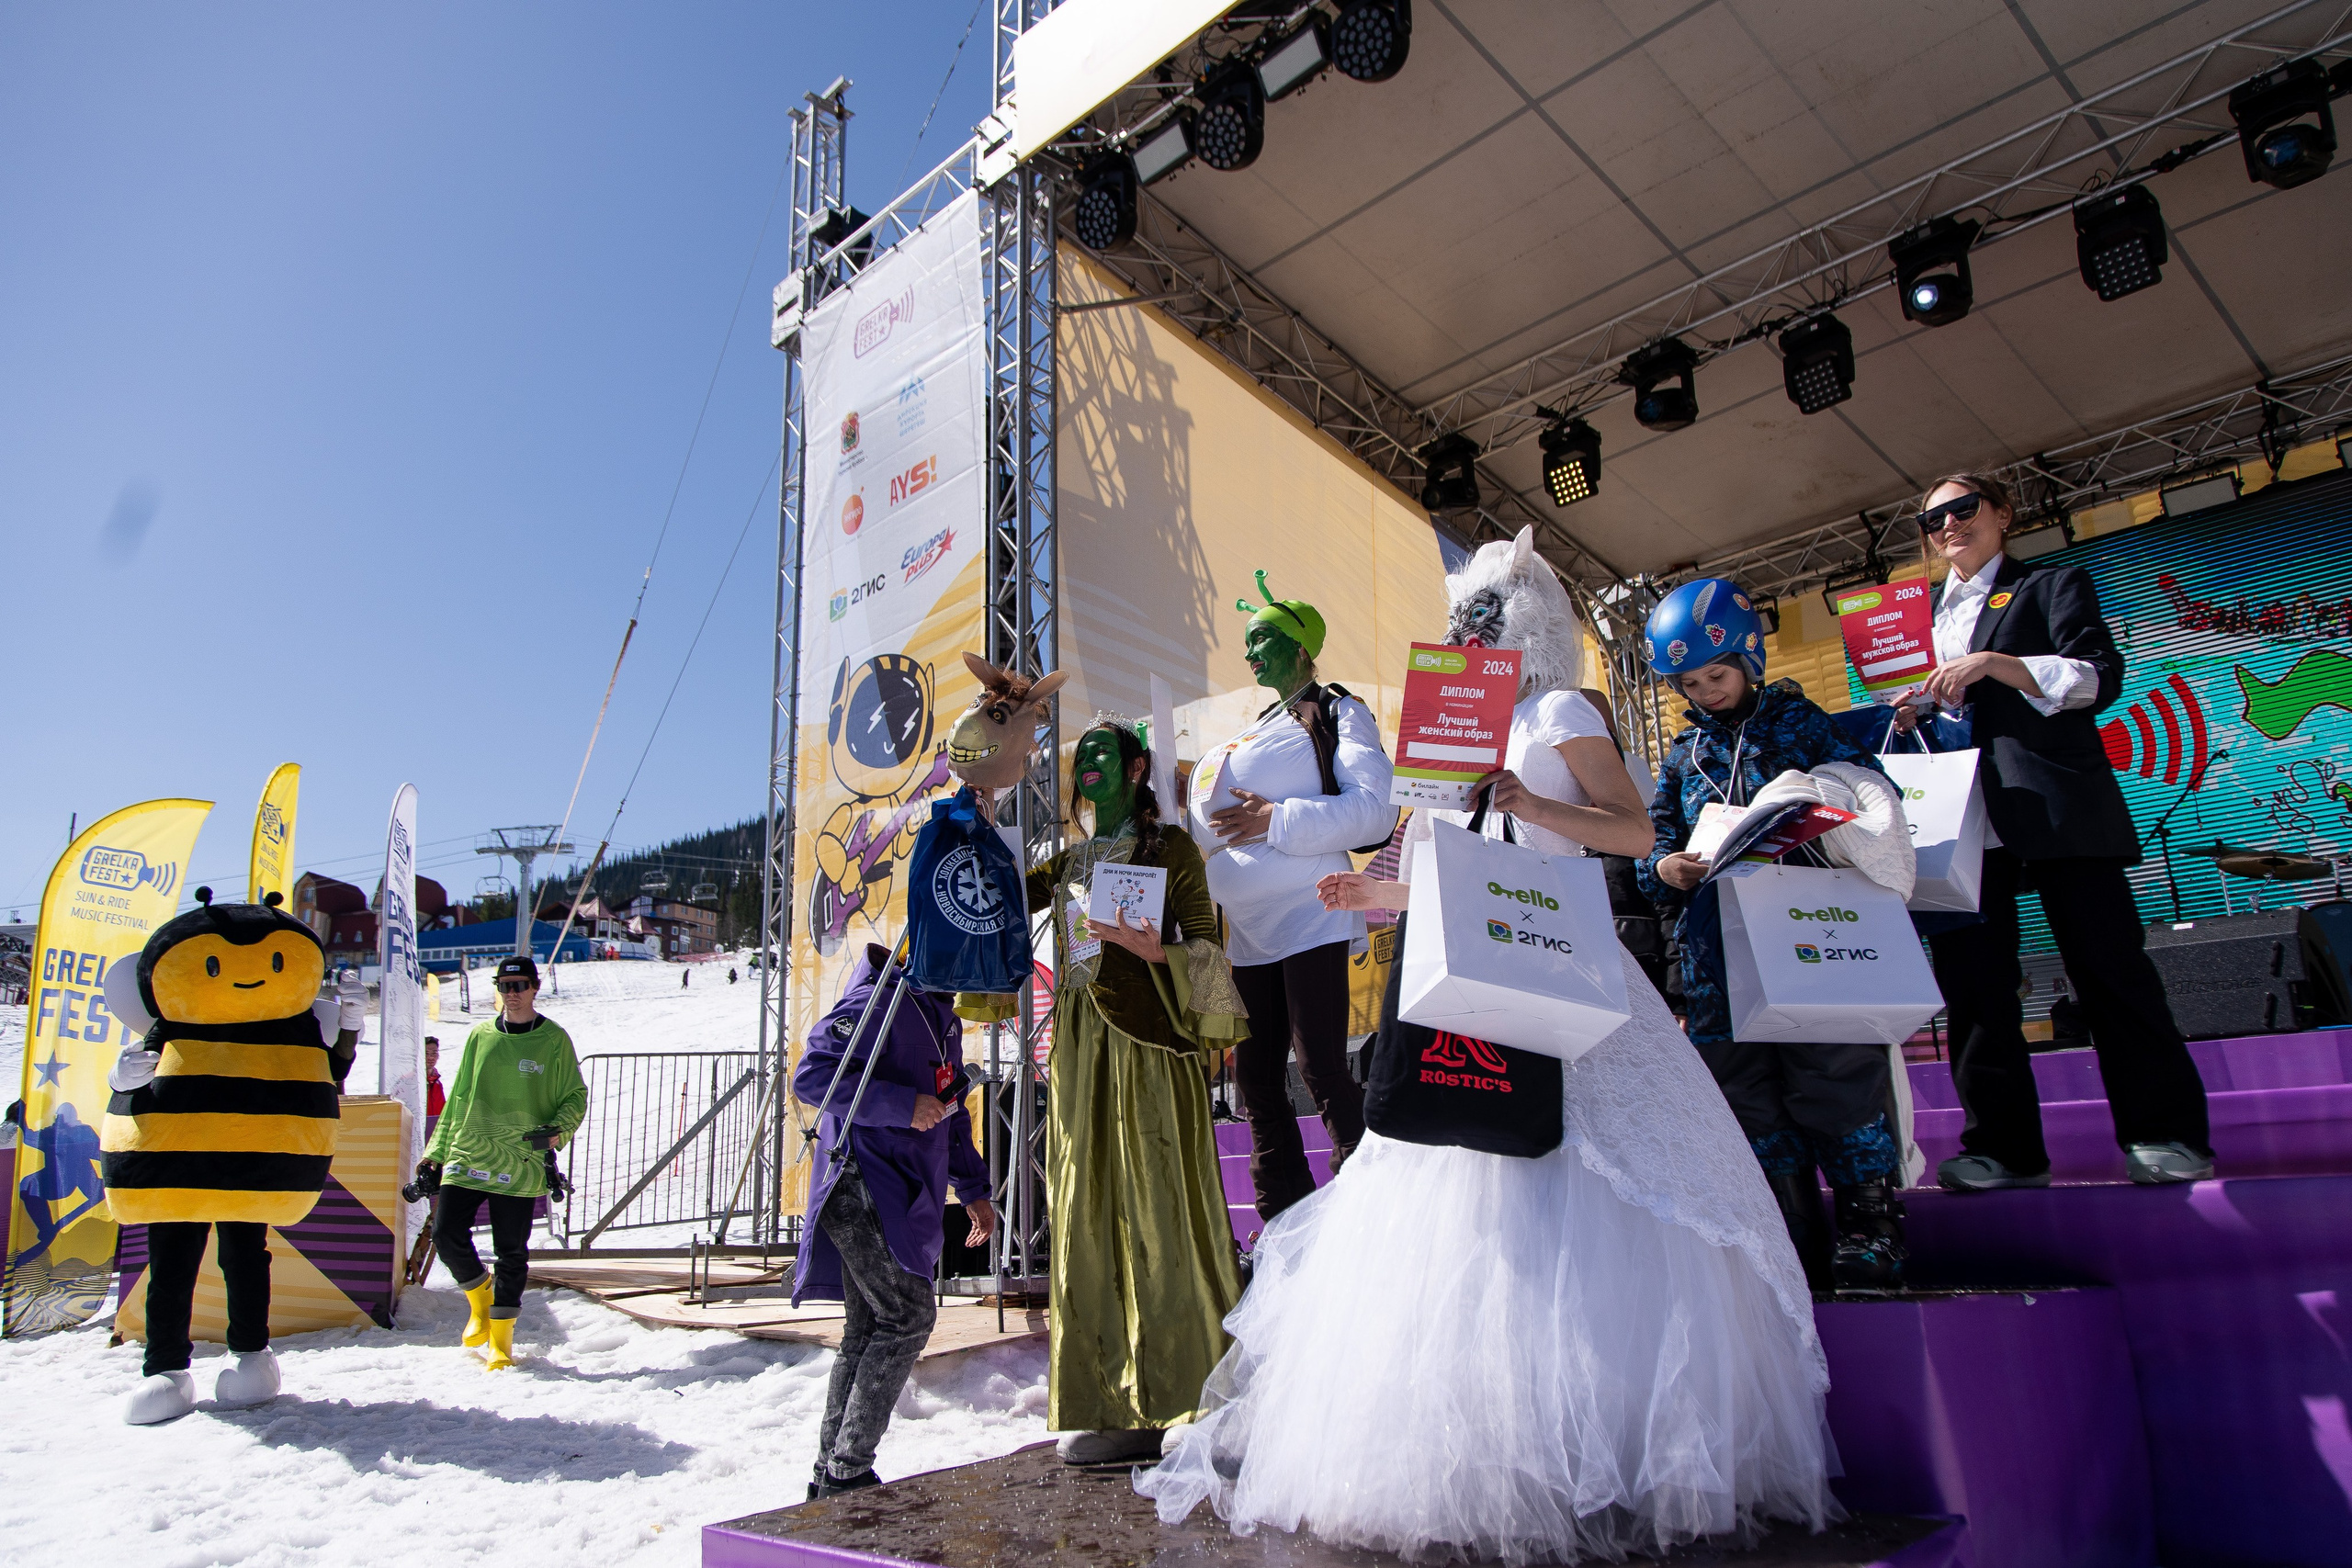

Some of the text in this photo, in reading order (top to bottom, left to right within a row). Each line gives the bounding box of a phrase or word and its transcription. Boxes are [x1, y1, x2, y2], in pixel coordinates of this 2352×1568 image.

[860, 307, 888, 336] GRELKA
[859, 328, 878, 352] FEST
[890, 454, 937, 506] AYS!
[851, 573, 886, 605] 2ГИС
[1895, 585, 1923, 601] 2024
[1867, 610, 1903, 627] ДИПЛОМ
[1861, 639, 1919, 660] мужской образ
[1871, 632, 1904, 649] Лучший
[1482, 660, 1513, 675] 2024
[1439, 685, 1485, 699] ДИПЛОМ
[1437, 713, 1478, 728] Лучший
[1418, 725, 1493, 742] женский образ
[1813, 810, 1845, 821] 2024
[93, 852, 139, 871] GRELKA
[89, 866, 120, 883] FEST
[74, 890, 131, 910] SUN & RIDE
[71, 907, 148, 931] MUSIC FESTIVAL
[937, 891, 997, 931] НОВОСИБИРСКАЯ
[1518, 931, 1573, 953] 2ГИС
[1378, 948, 1390, 961] FEST
[1824, 948, 1878, 960] 2ГИС
[43, 948, 107, 988] GREL
[1419, 1069, 1512, 1092] ROSTIC'S
